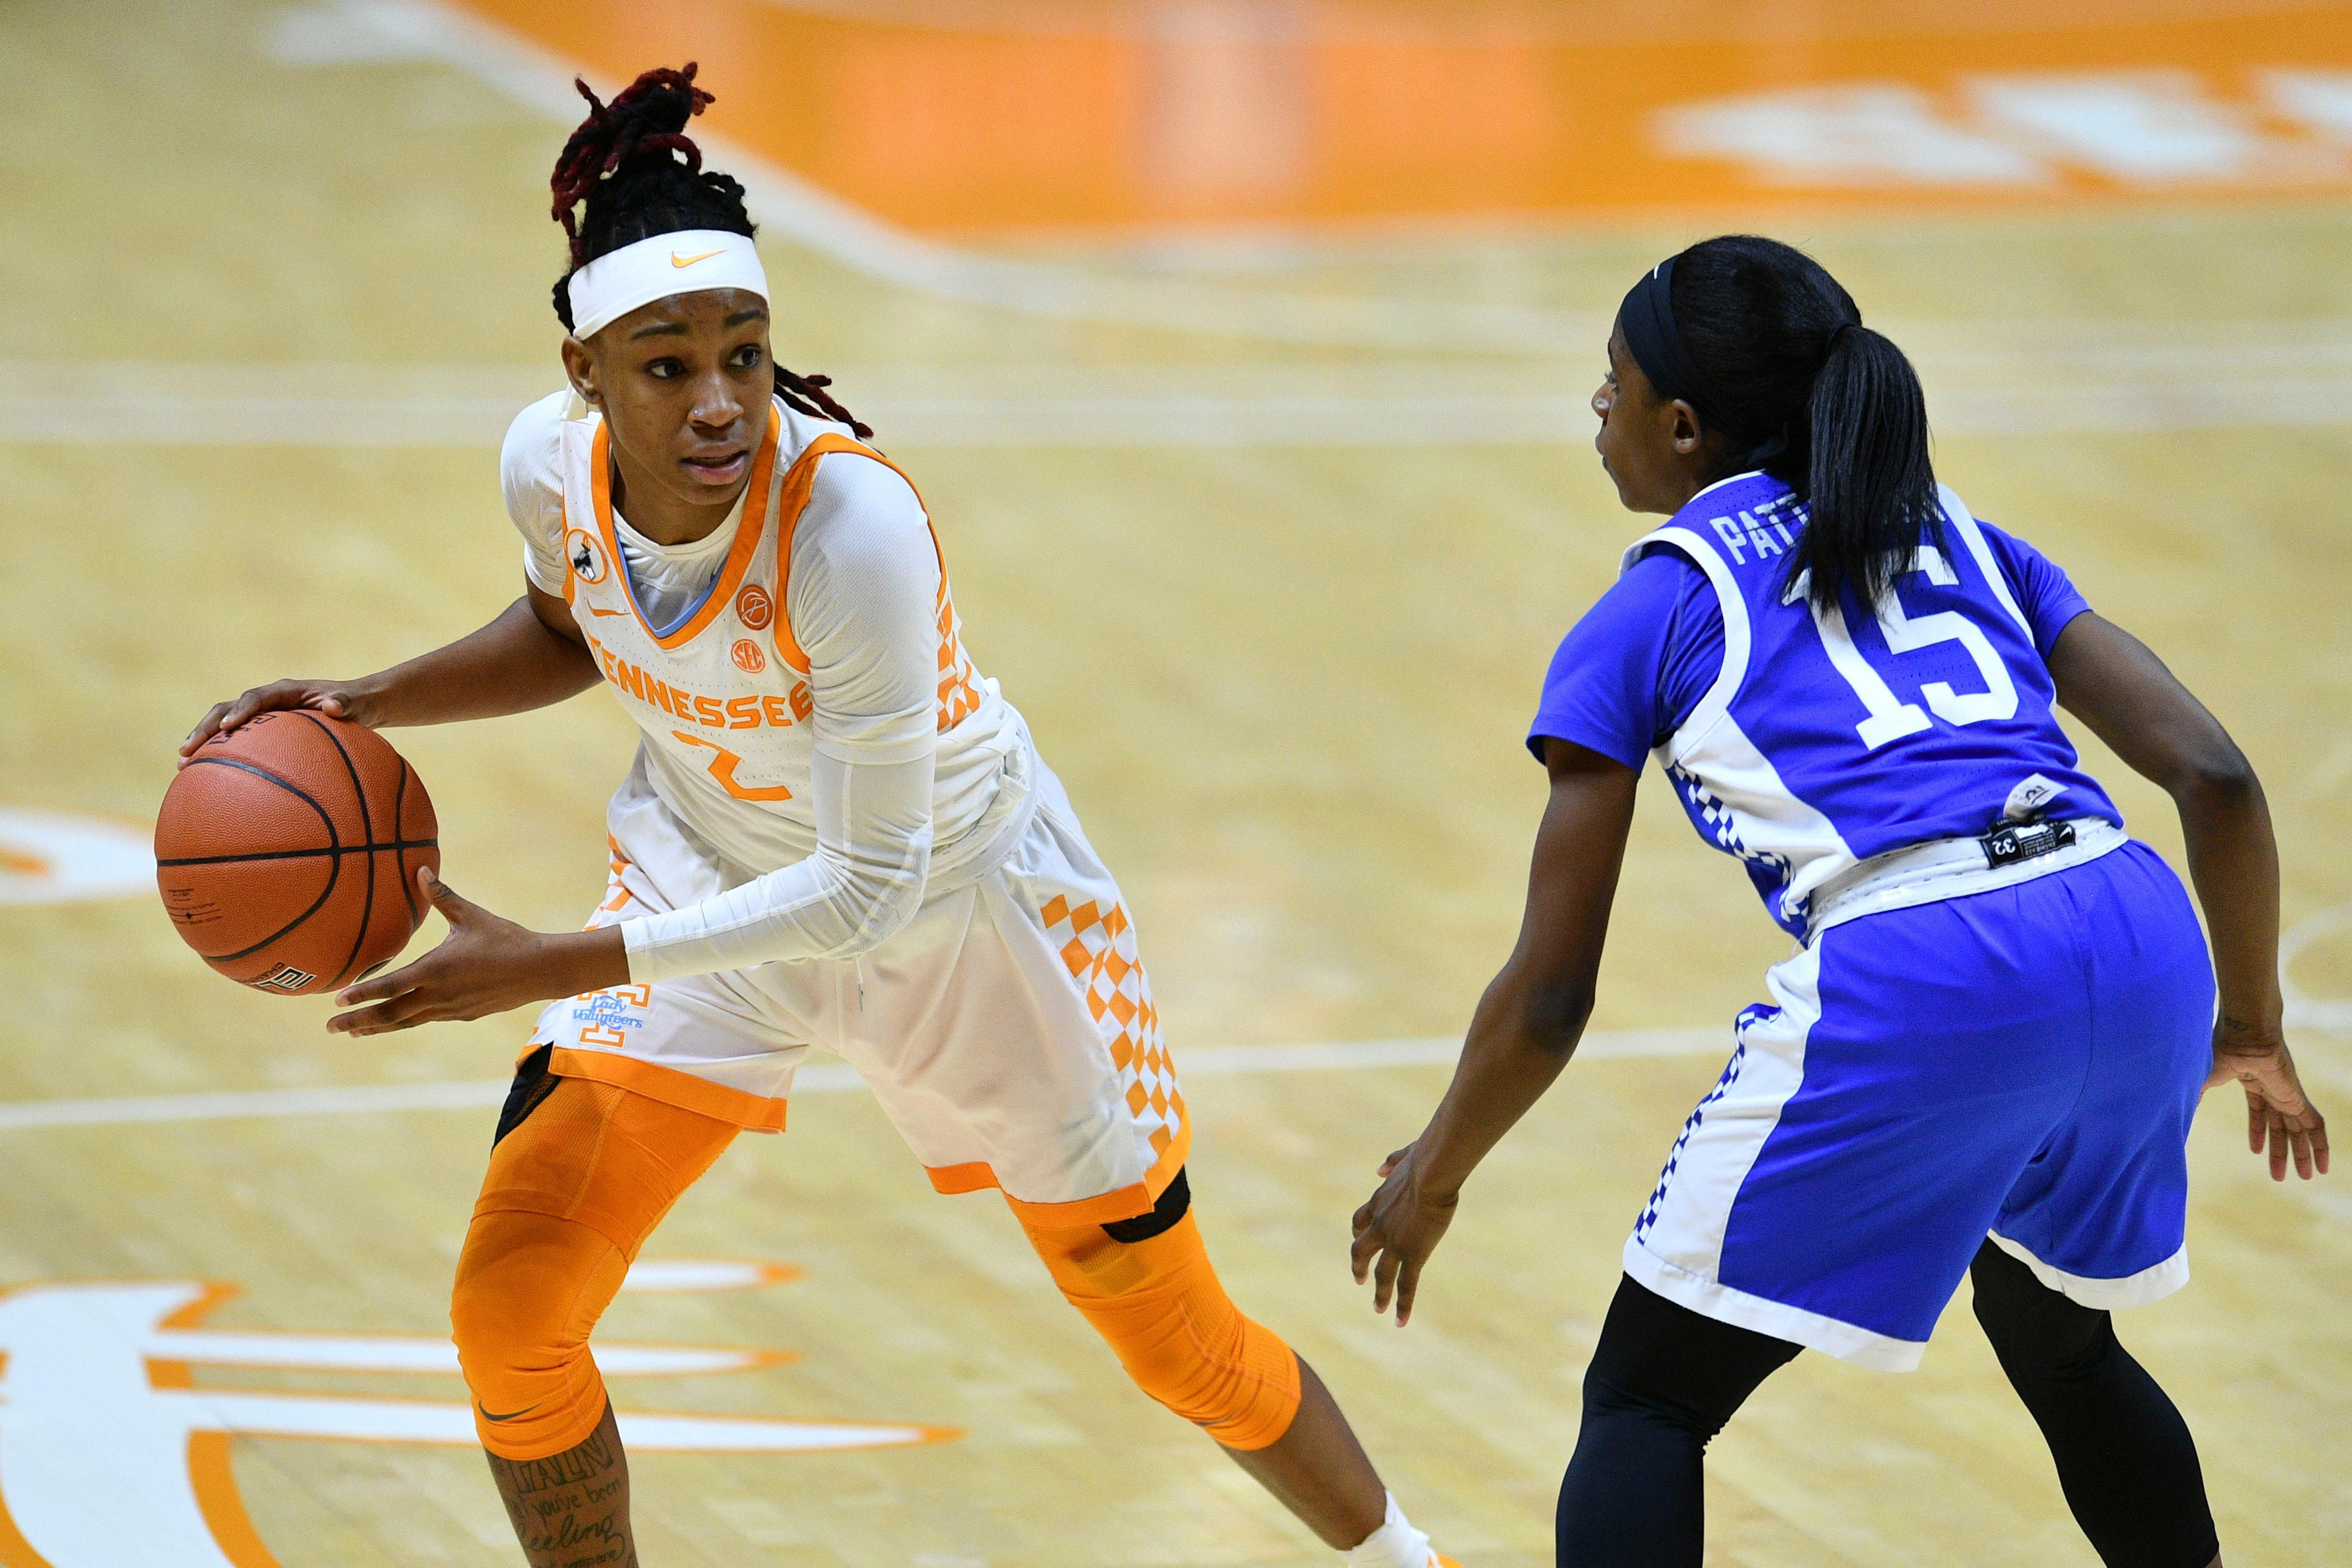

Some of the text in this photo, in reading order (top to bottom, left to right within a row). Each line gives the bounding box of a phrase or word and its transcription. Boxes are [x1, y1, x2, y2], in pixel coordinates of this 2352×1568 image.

[734, 643, 763, 671] SEC
[1781, 545, 2019, 751] 15
[587, 630, 813, 729] TENNESSEE
[672, 730, 793, 801] 2
[1991, 837, 2016, 855] 32
[590, 995, 627, 1014] Lady
[573, 1008, 644, 1030] Volunteers
